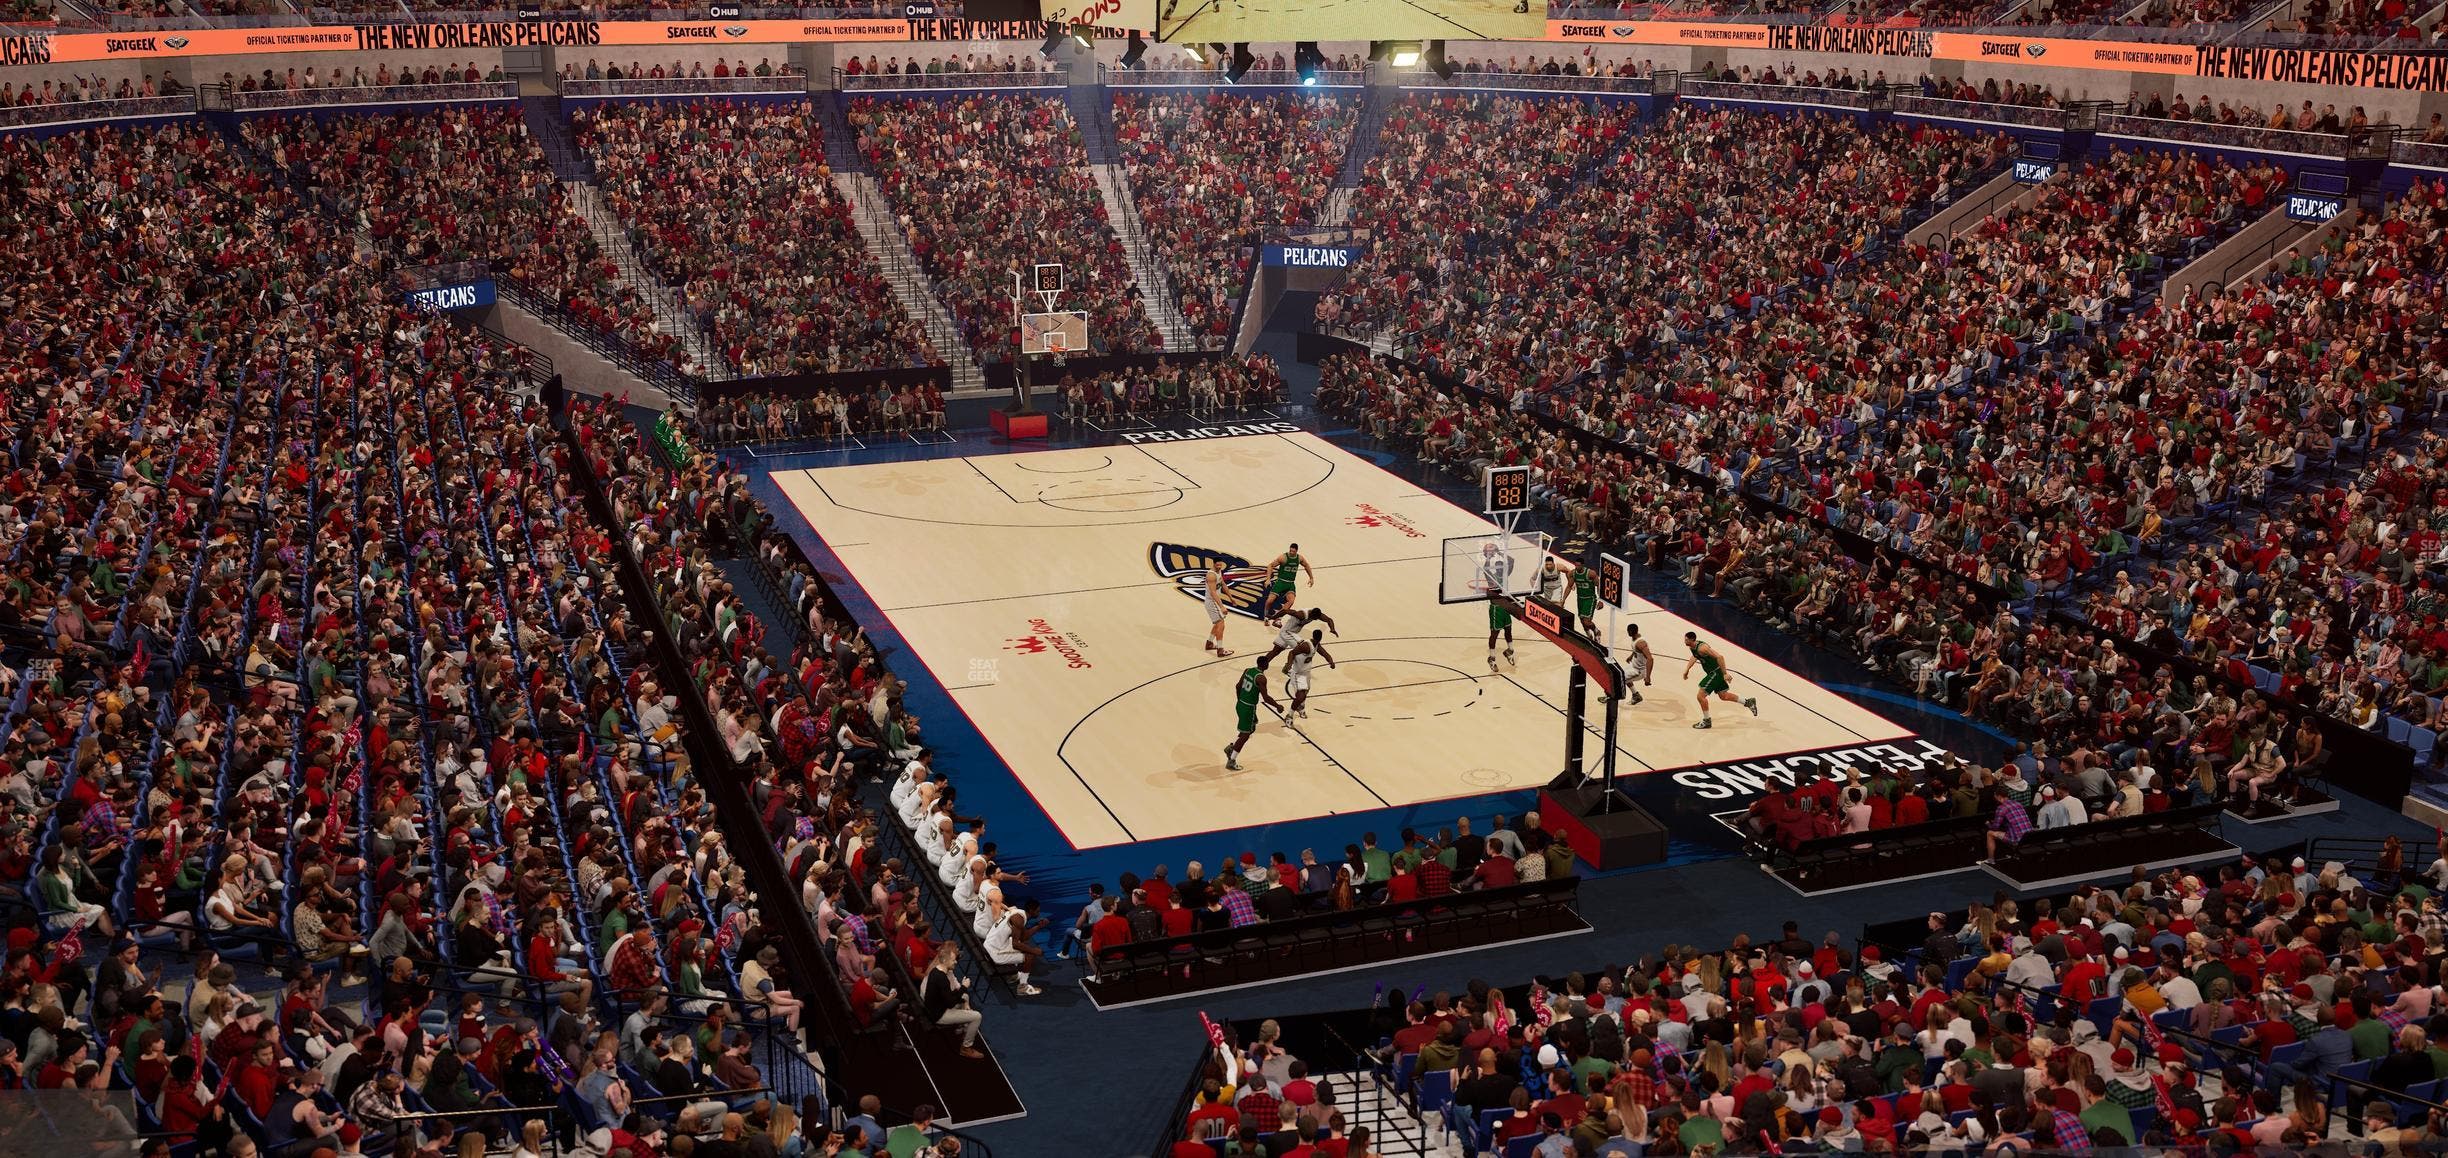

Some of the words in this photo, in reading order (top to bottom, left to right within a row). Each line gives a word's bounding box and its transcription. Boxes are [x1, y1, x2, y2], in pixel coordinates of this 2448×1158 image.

[721, 8, 739, 16] HUB
[246, 36, 276, 46] OFFICIAL
[276, 34, 310, 45] TICKETING
[310, 34, 342, 44] PARTNER
[343, 33, 353, 43] OF
[354, 25, 389, 50] THE
[391, 24, 429, 49] NEW
[434, 23, 513, 48] ORLEANS
[516, 22, 600, 46] PELICANS
[667, 25, 718, 39] SEATGEEK
[803, 26, 833, 35] OFFICIAL
[834, 26, 867, 35] TICKETING
[867, 26, 896, 34] PARTNER
[897, 25, 905, 34] OF
[907, 19, 937, 40] THE
[939, 19, 975, 40] NEW
[1561, 24, 1606, 38] SEATGEEK
[0, 36, 51, 65] ICANS
[106, 37, 158, 53] SEATGEEK
[1679, 29, 1703, 39] OFFICIAL
[1704, 30, 1732, 40] TICKETING
[1732, 31, 1757, 41] PARTNER
[1757, 32, 1765, 41] OF
[1767, 25, 1793, 49] THE
[1796, 25, 1822, 51] NEW
[1823, 27, 1874, 54] ORLEANS
[1876, 29, 1933, 58] PELICANS
[1981, 40, 2022, 58] SEATGEEK
[2094, 49, 2121, 62] OFFICIAL
[2122, 51, 2154, 64] TICKETING
[2154, 53, 2183, 65] PARTNER
[2184, 55, 2193, 66] OF
[2196, 46, 2227, 78] THE
[2228, 47, 2269, 80] NEW
[2271, 49, 2359, 86] ORLEANS
[2361, 53, 2448, 92] PELICAN
[2016, 163, 2051, 182] PELICANS
[2290, 197, 2338, 219] PELICANS
[1283, 247, 1348, 267] PELICANS
[1120, 422, 1301, 444] PELICANS
[1495, 474, 1508, 486] 88
[1511, 473, 1525, 485] 88
[1499, 486, 1521, 506] 88
[1529, 604, 1556, 630] SEATGEEK
